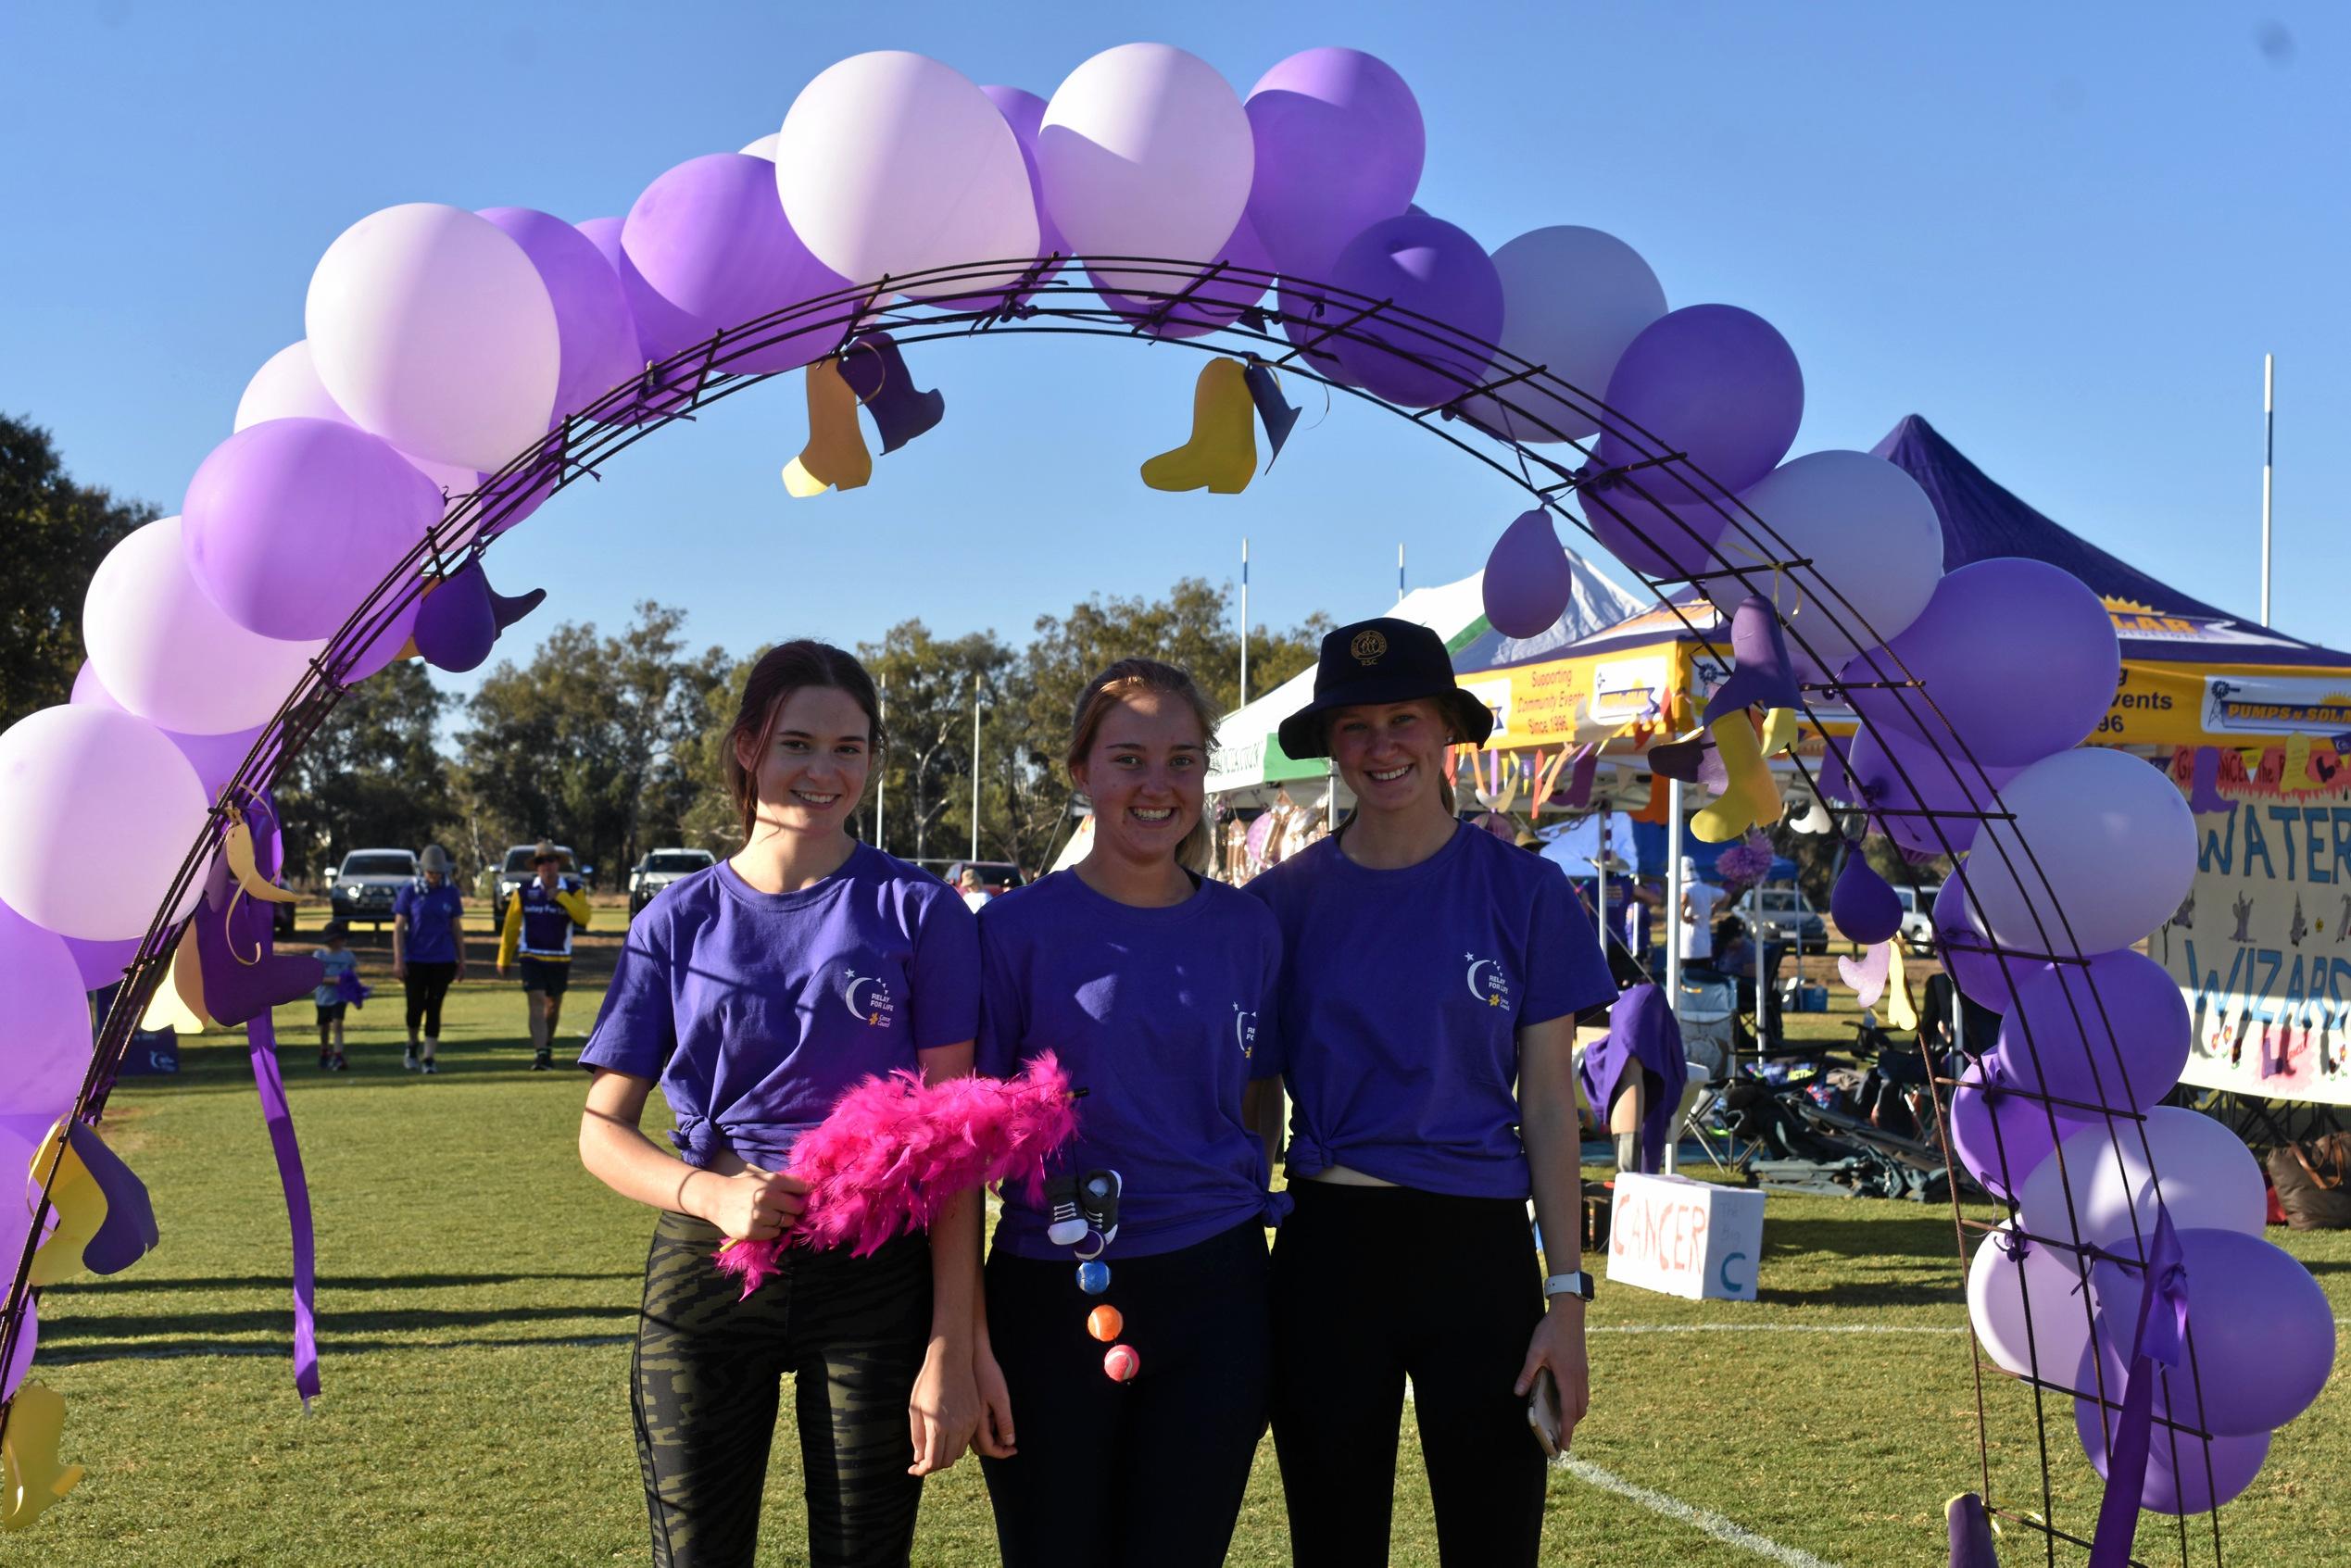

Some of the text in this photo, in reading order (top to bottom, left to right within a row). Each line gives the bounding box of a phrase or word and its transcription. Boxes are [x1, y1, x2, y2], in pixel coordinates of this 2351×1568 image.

[2110, 614, 2197, 634] LAR
[2112, 692, 2173, 710] vents
[2097, 714, 2124, 733] 96
[2228, 704, 2291, 721] PUMPS
[2307, 708, 2351, 724] SOLA
[872, 993, 890, 1003] RELAY
[883, 1003, 893, 1011] LIFE
[1613, 1193, 1706, 1274] CANCER
[1720, 1251, 1746, 1293] C
